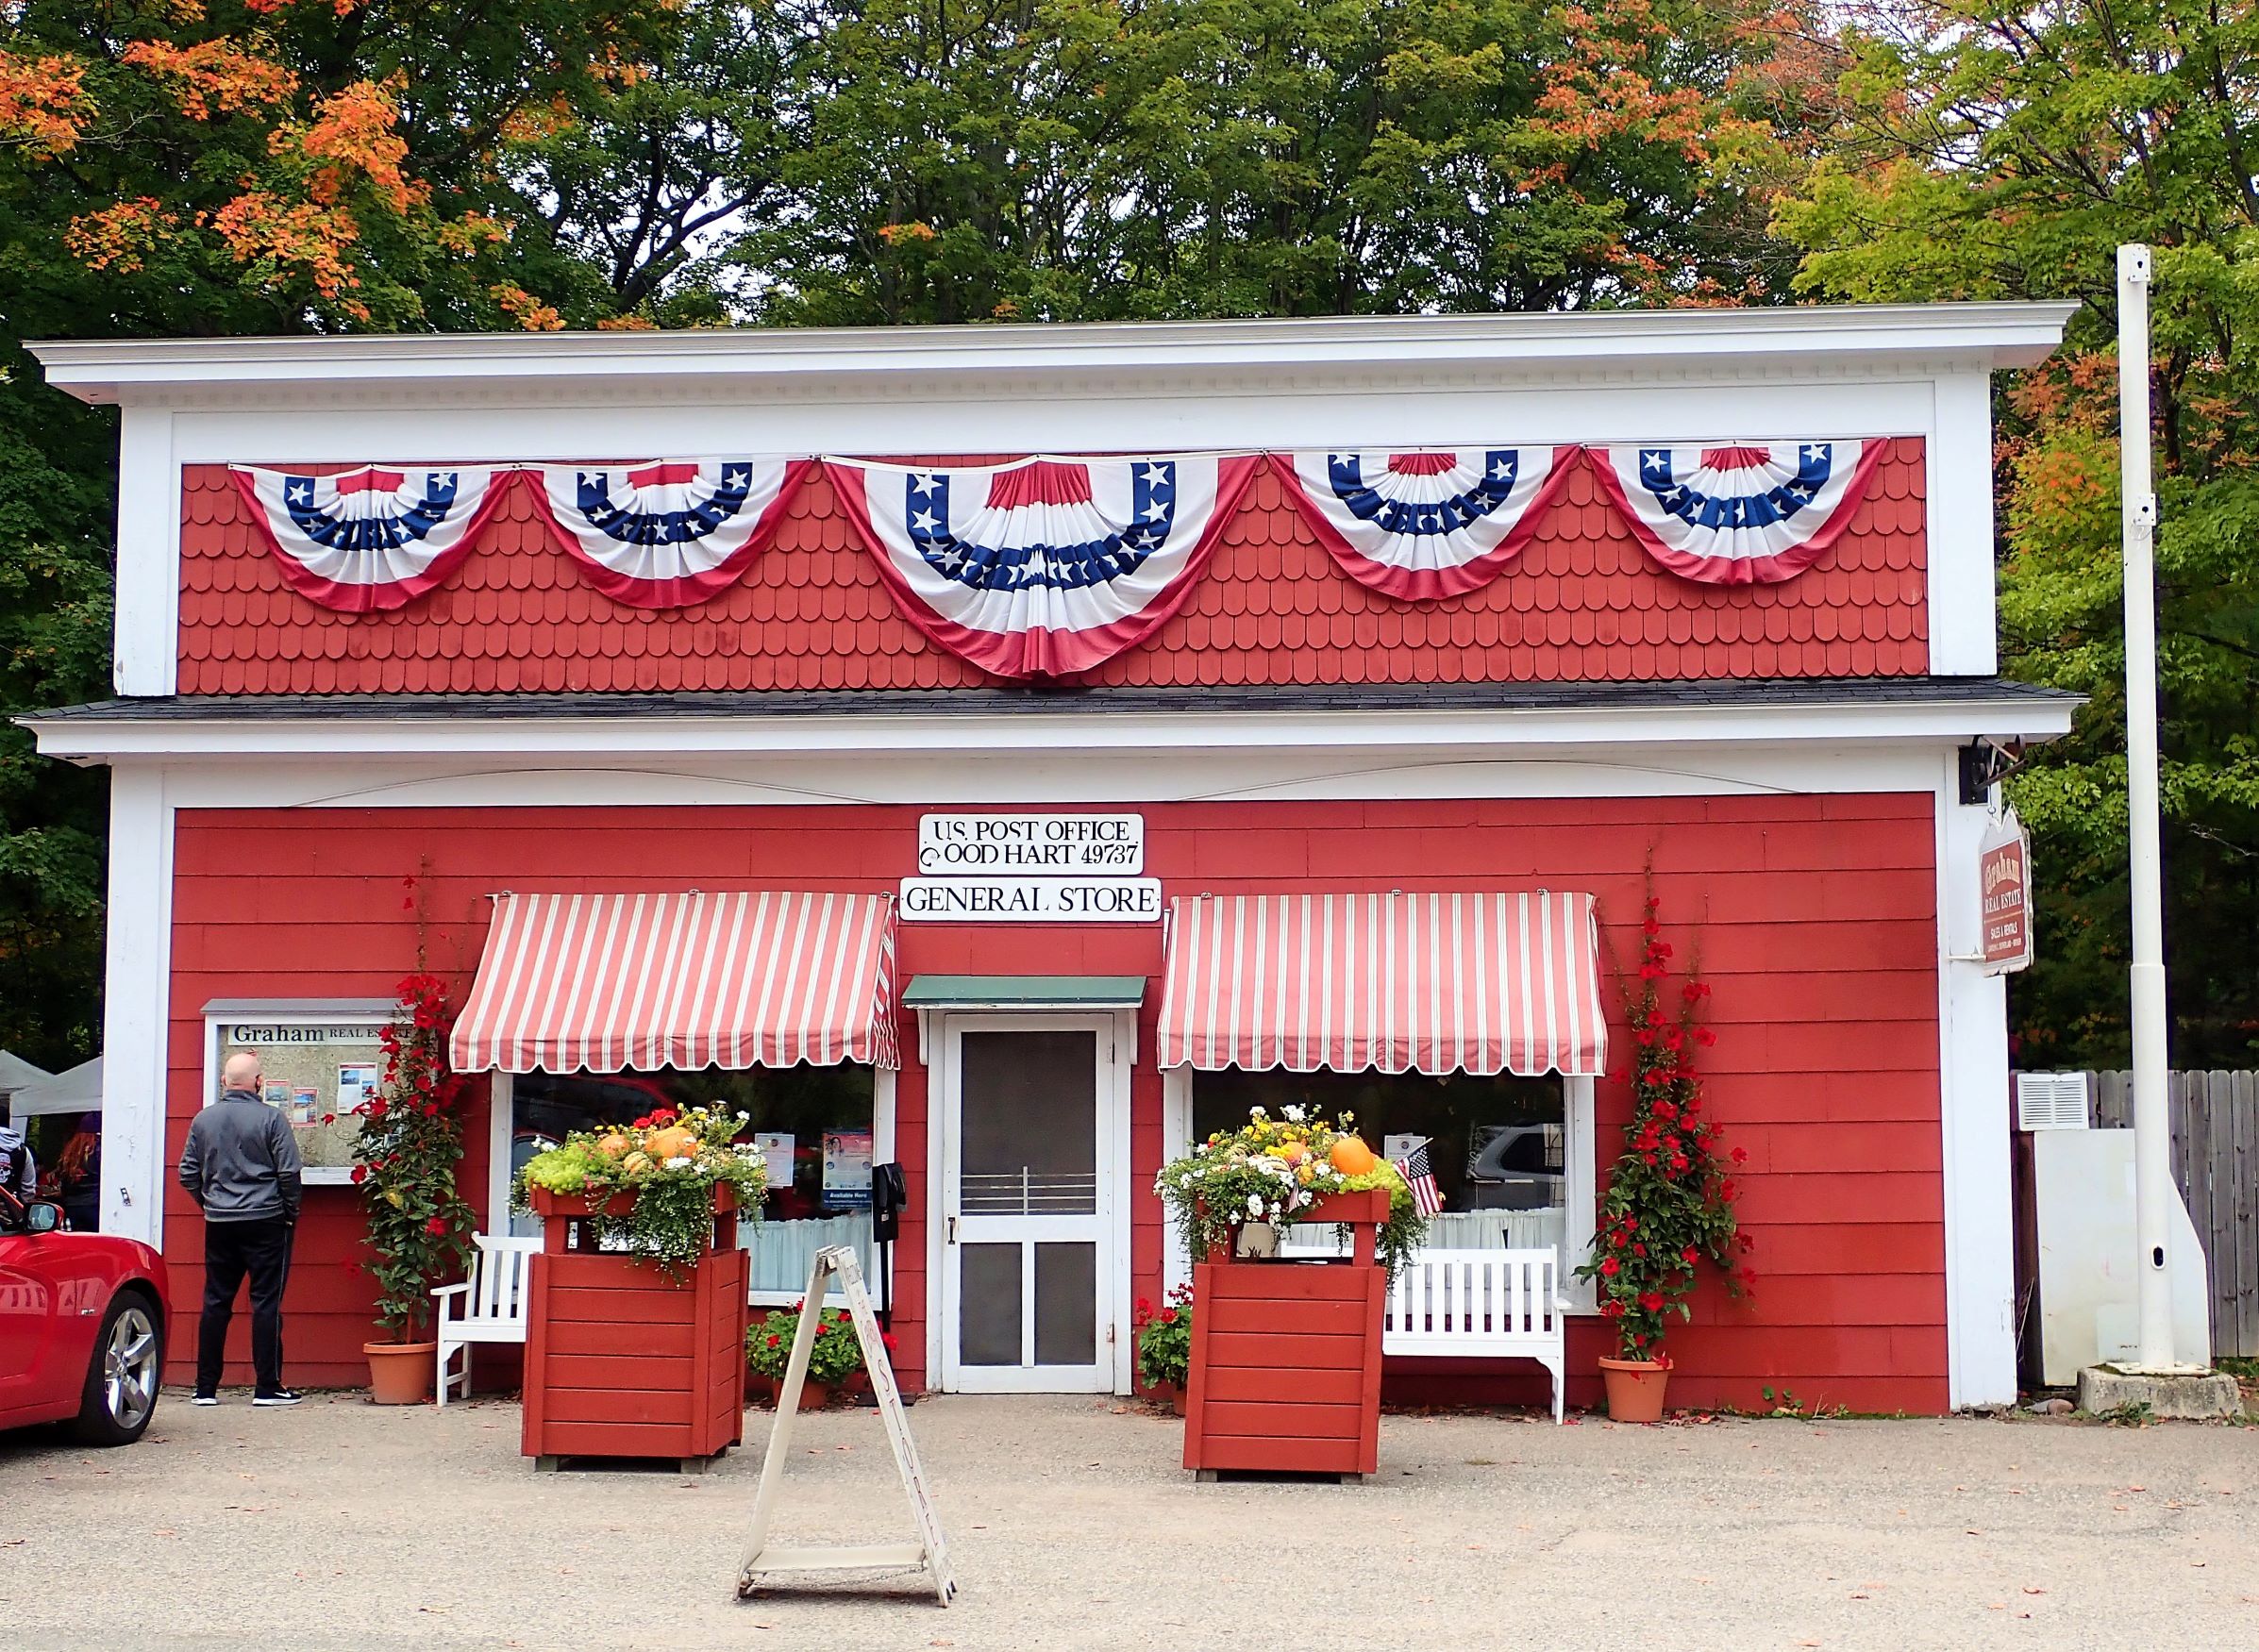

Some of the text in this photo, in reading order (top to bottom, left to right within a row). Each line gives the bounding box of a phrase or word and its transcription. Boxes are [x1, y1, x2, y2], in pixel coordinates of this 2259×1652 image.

[932, 821, 1130, 841] U.S. POST OFFICE
[1003, 844, 1076, 864] HART
[1081, 843, 1138, 864] 49737
[1984, 852, 2020, 895] Graham
[906, 887, 1156, 912] GENERAL STORE
[1984, 888, 2022, 914] REAL ESTATE
[234, 1025, 325, 1043] Graham
[329, 1028, 363, 1038] REAL
